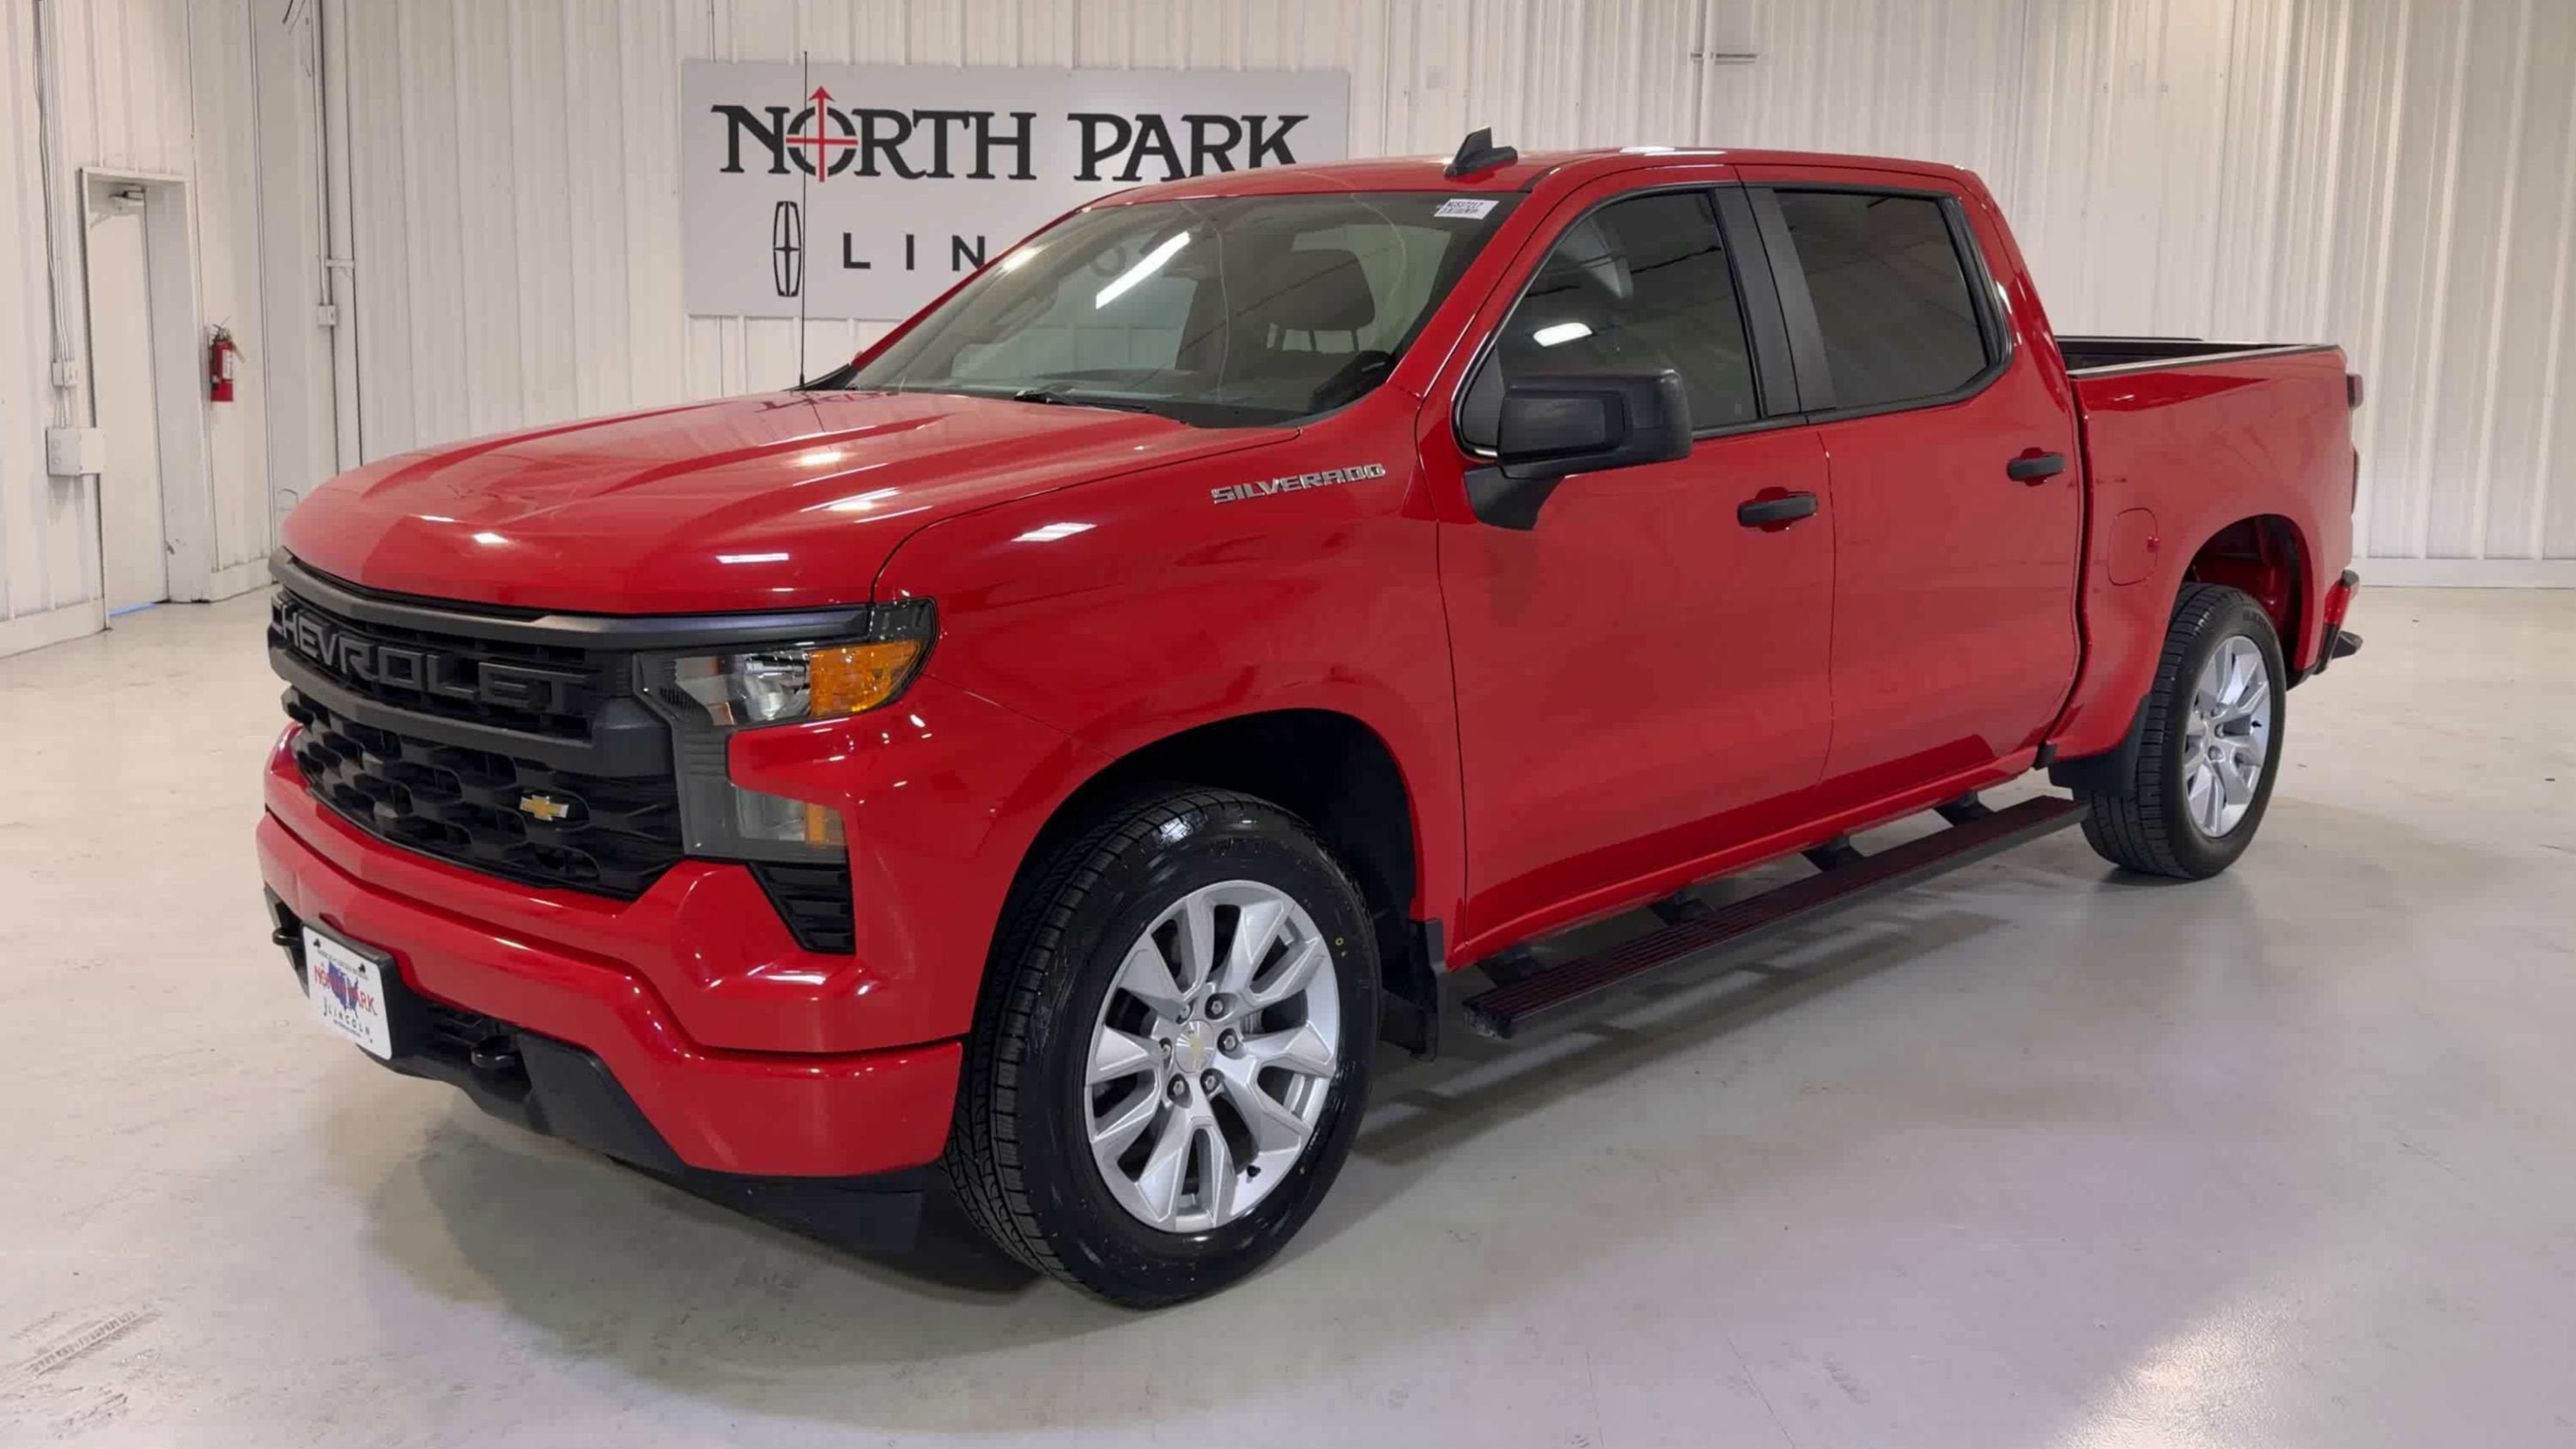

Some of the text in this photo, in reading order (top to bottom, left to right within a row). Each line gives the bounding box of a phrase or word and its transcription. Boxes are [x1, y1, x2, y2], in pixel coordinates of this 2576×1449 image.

[711, 104, 1309, 182] NORTH PARK
[843, 232, 987, 271] LIN
[1211, 463, 1386, 504] SILVERADO
[271, 594, 588, 716] CHEVROLET
